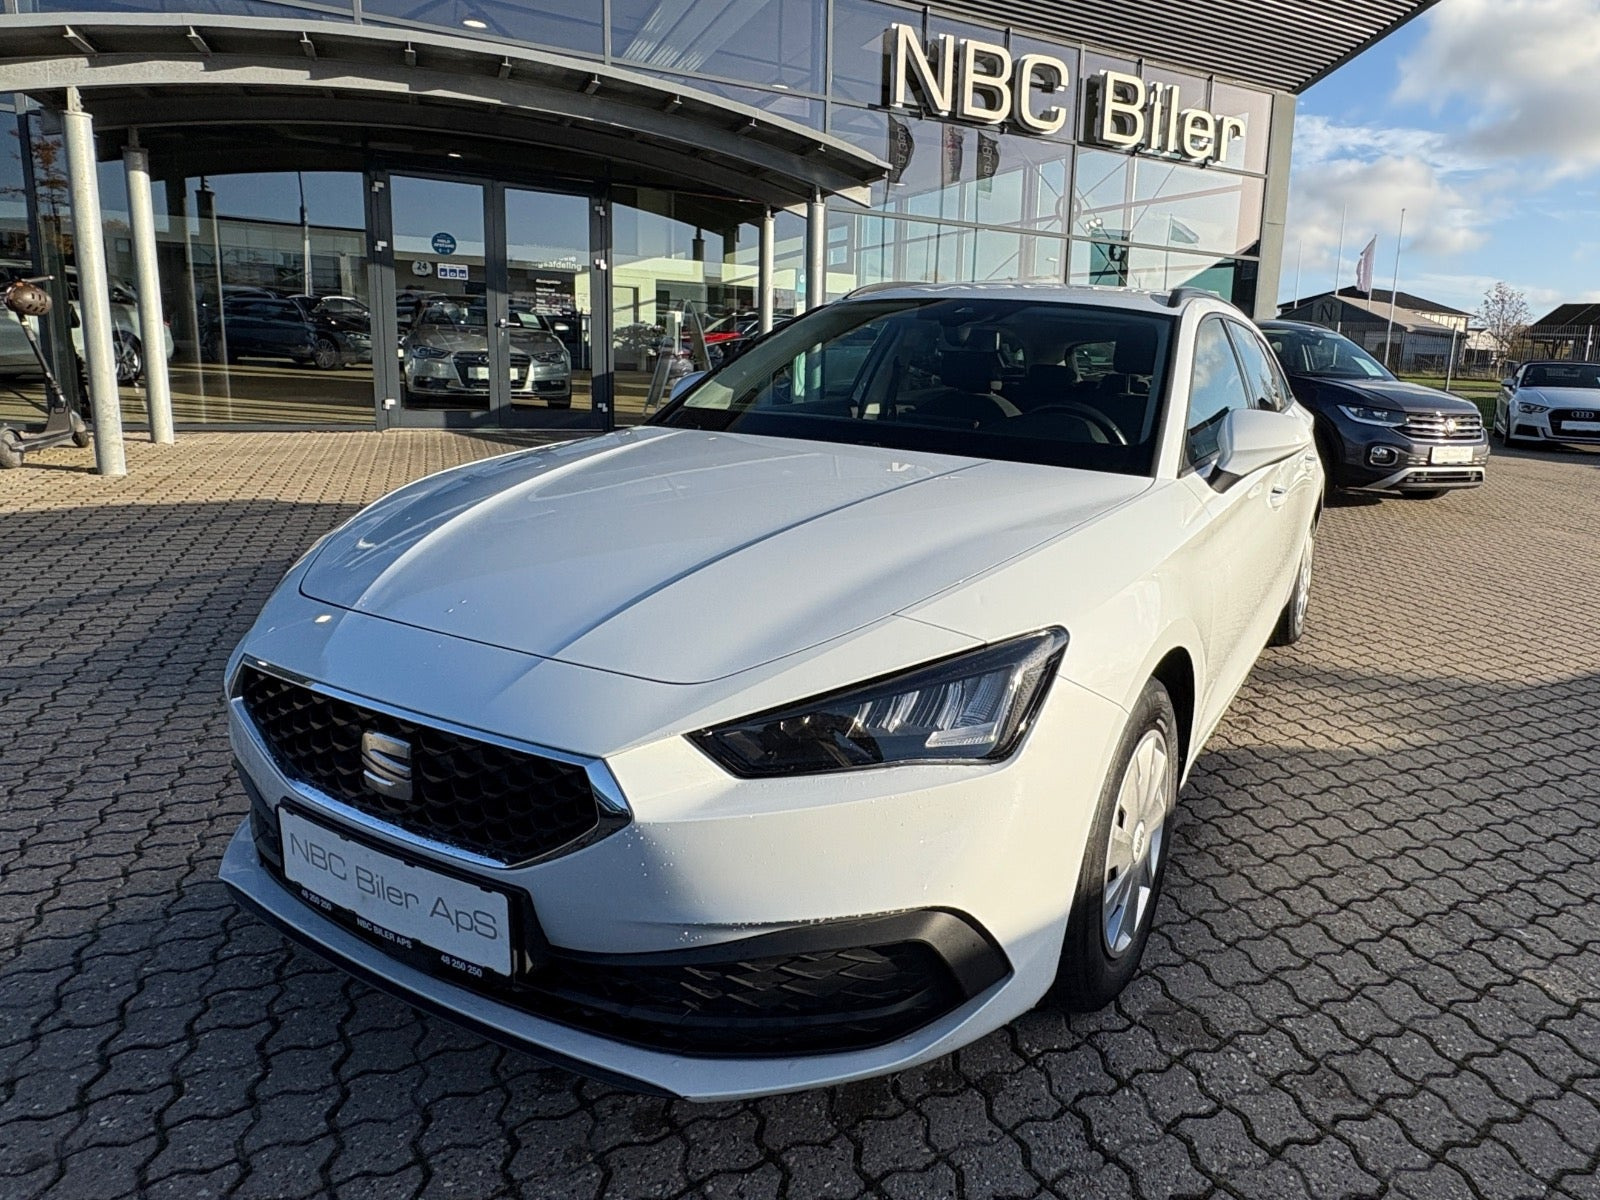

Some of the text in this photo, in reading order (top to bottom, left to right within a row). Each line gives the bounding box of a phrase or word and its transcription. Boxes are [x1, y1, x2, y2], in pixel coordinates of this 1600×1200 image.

[891, 22, 1246, 164] NBC Biler
[290, 832, 498, 940] NBC Biler ApS
[356, 917, 413, 949] NBC BILER APS
[451, 958, 466, 971] 250
[467, 964, 483, 978] 250
